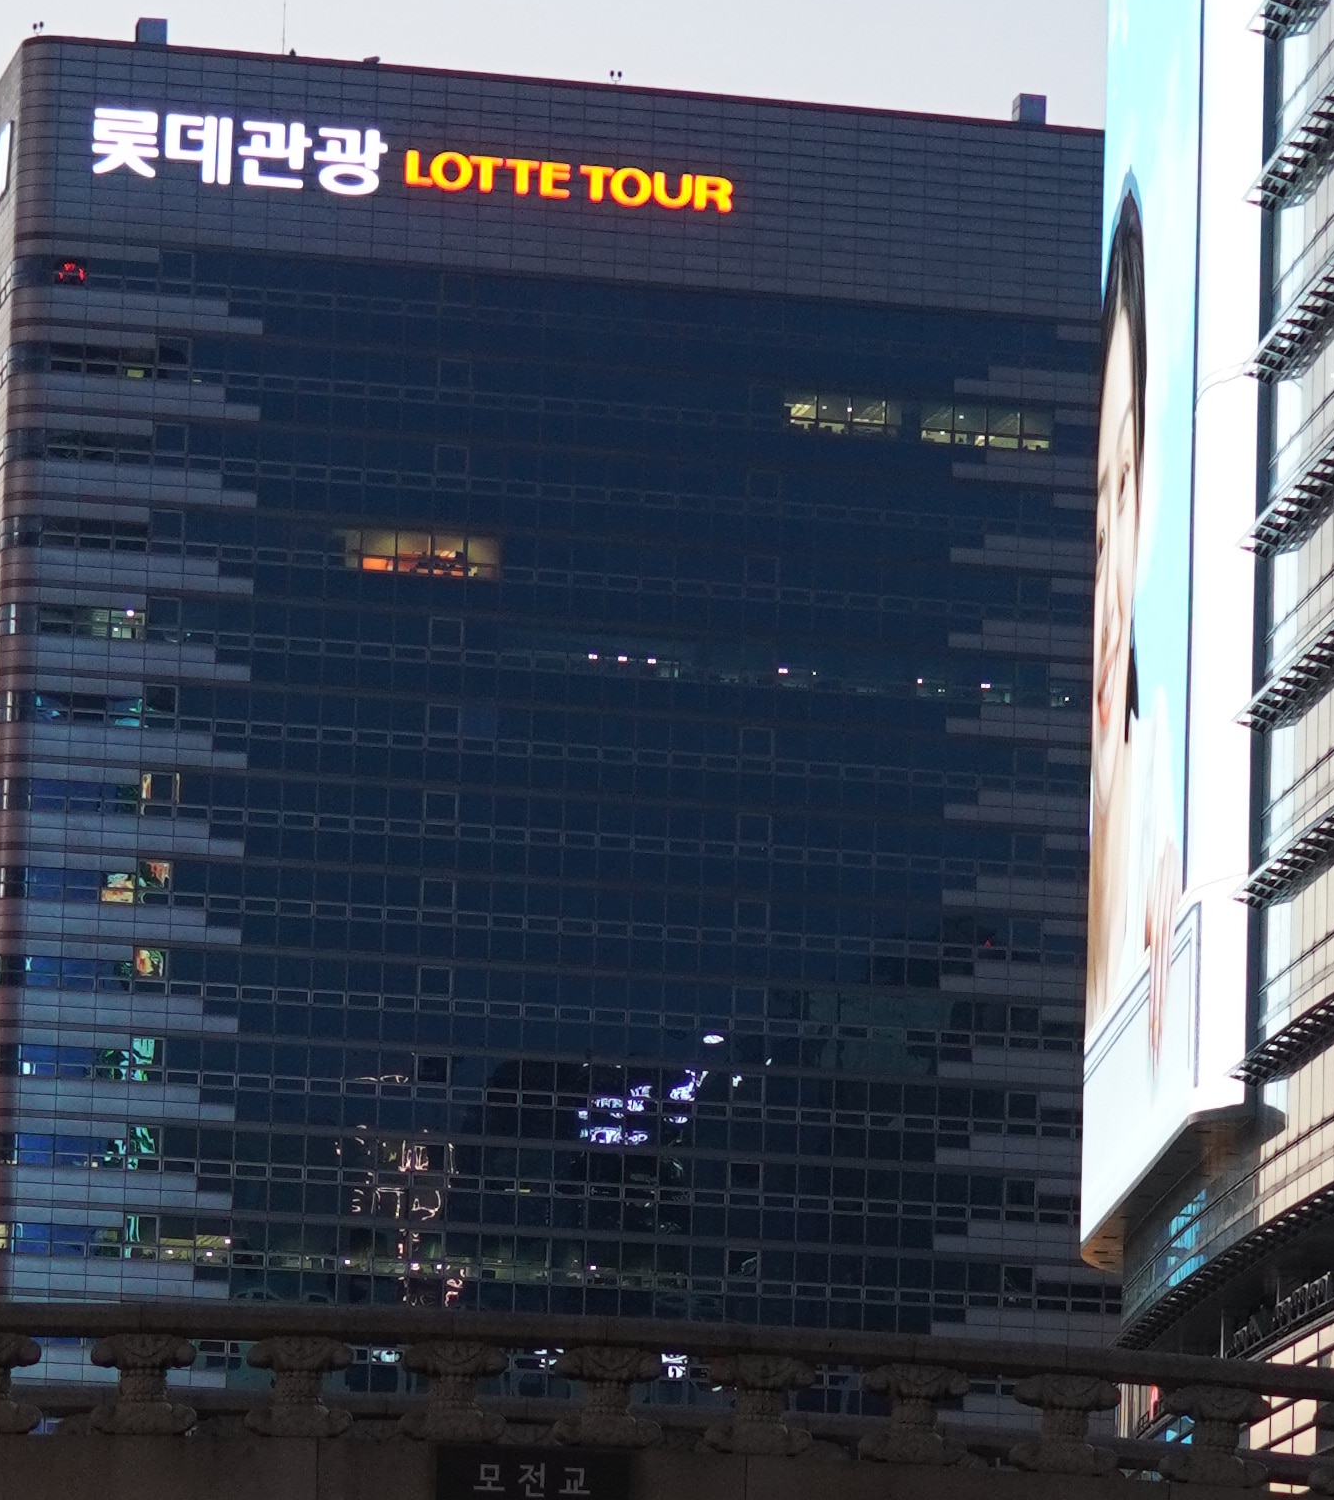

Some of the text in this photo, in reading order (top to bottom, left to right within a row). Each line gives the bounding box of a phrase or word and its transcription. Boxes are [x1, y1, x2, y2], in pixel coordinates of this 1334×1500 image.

[92, 106, 388, 196] 롯데관광
[404, 148, 734, 214] LOTTE TOUR
[472, 1462, 591, 1498] 모전교
